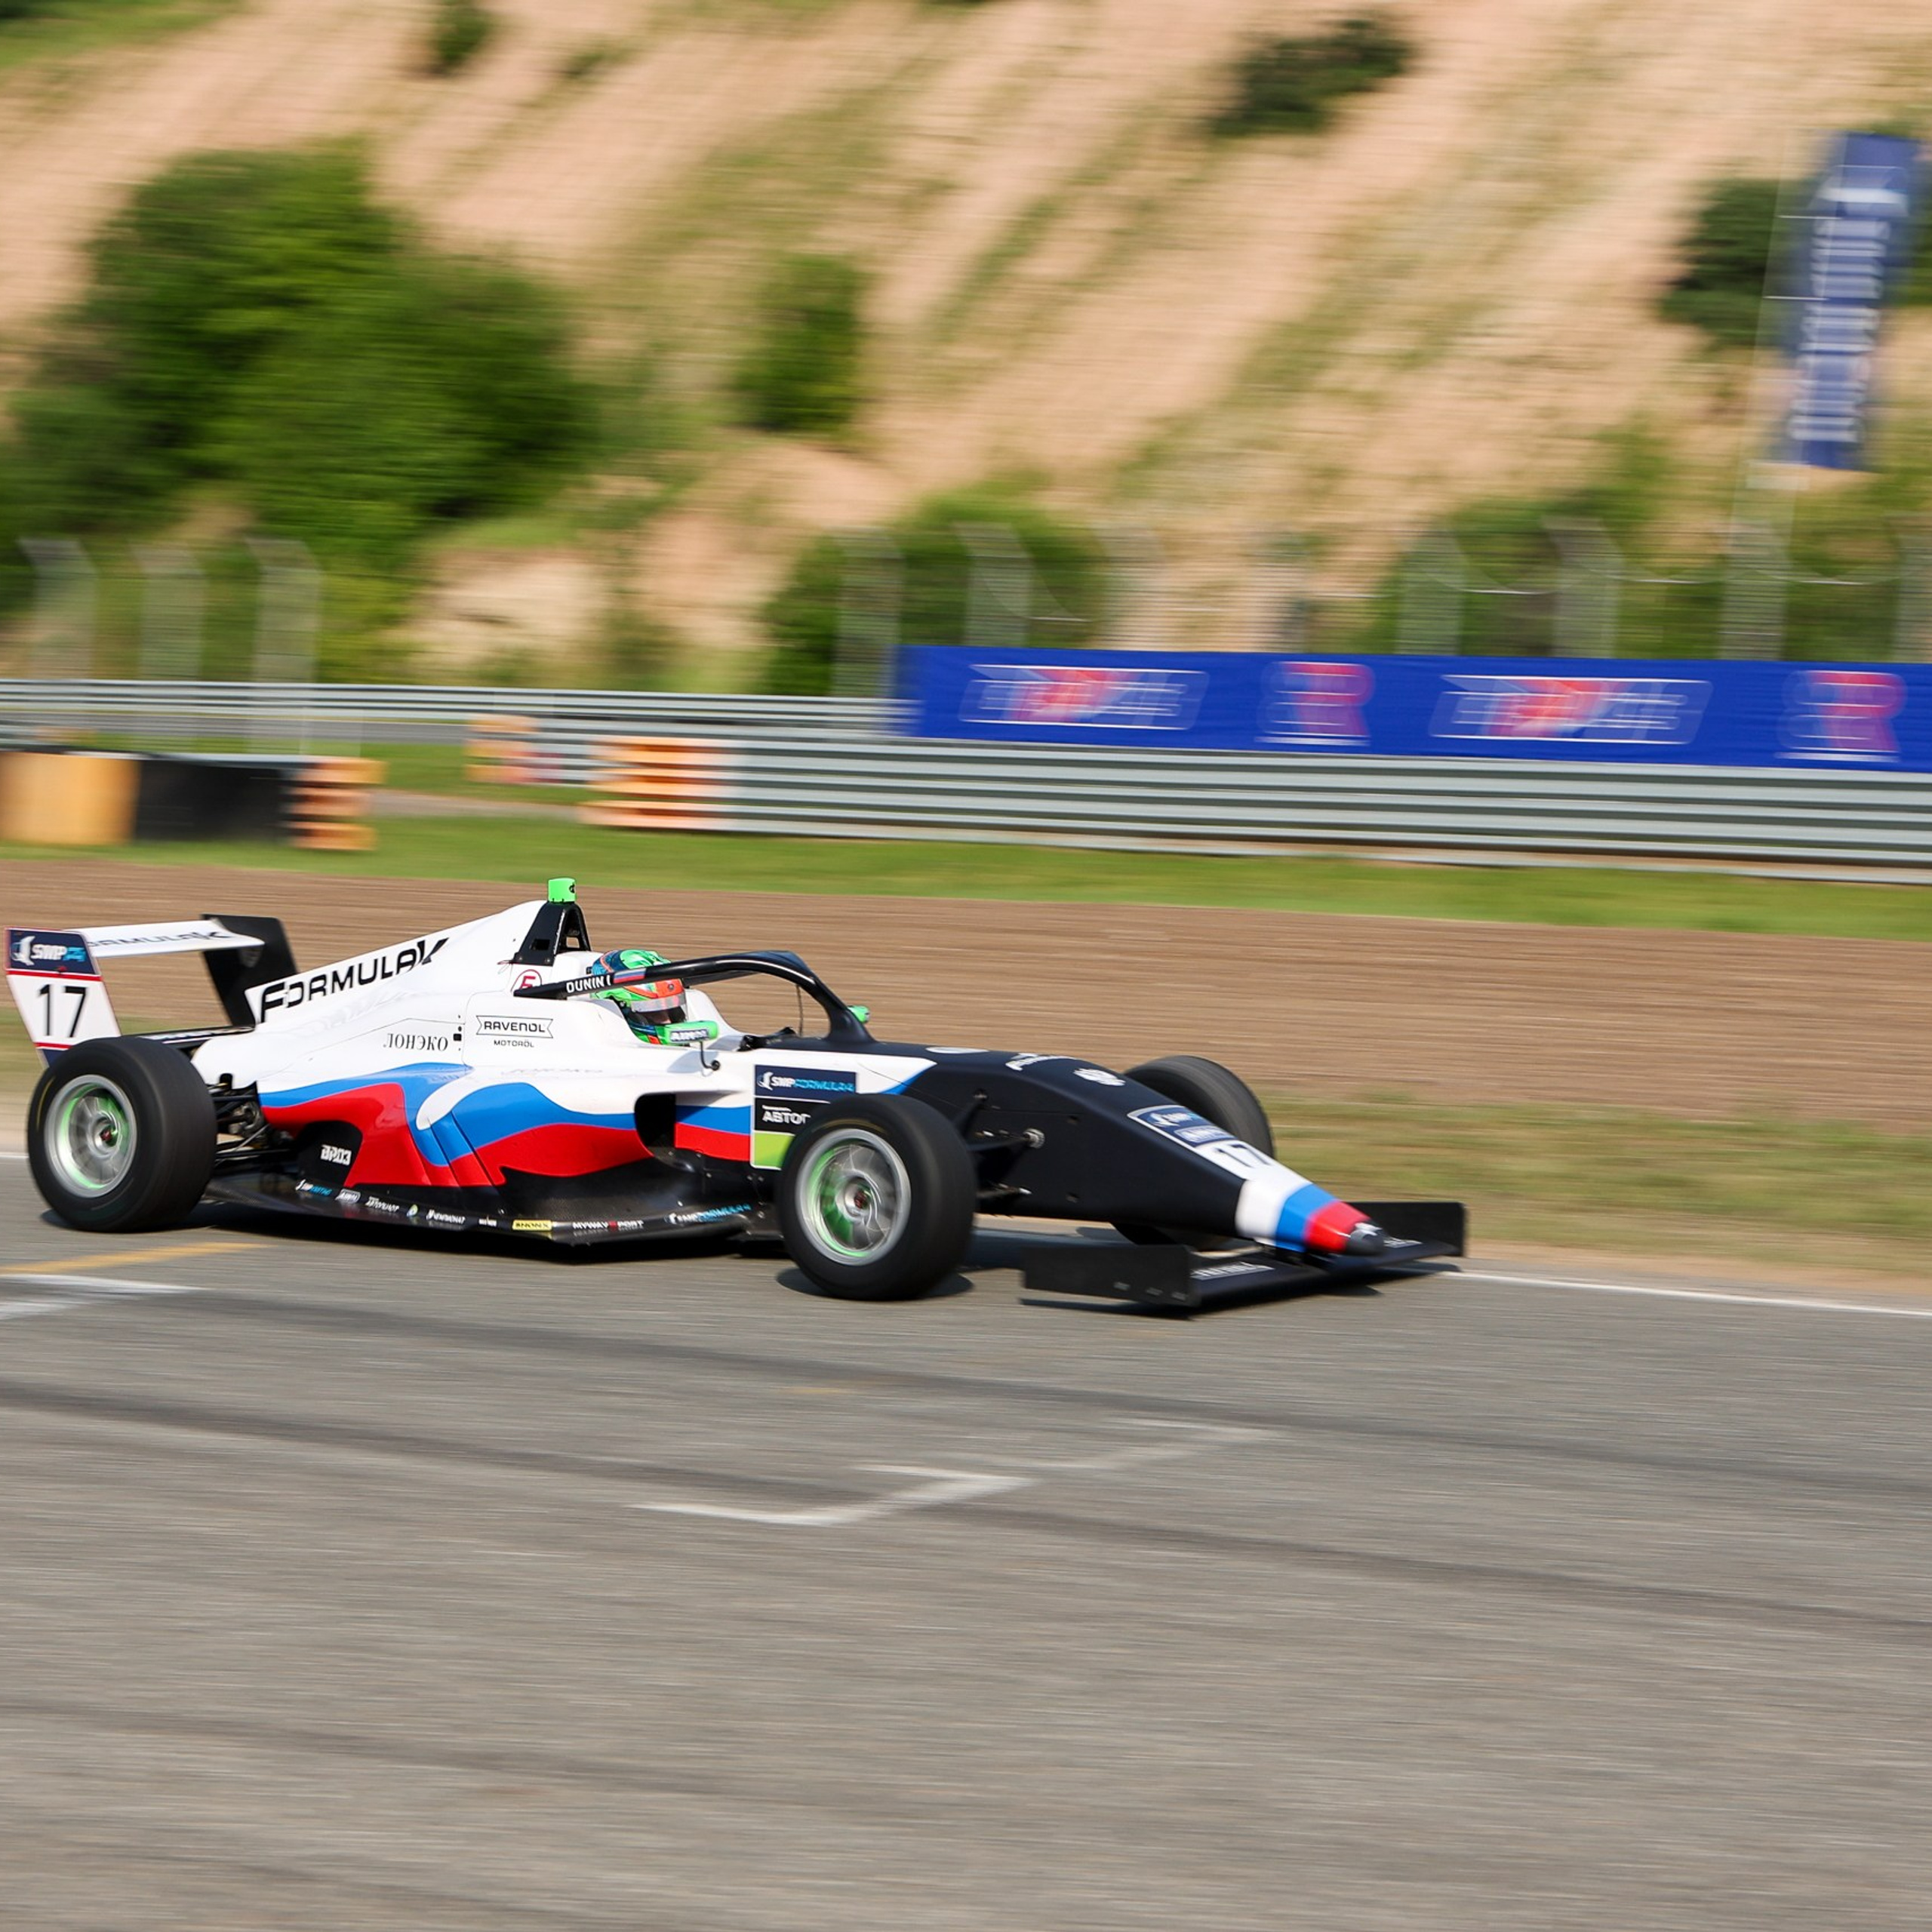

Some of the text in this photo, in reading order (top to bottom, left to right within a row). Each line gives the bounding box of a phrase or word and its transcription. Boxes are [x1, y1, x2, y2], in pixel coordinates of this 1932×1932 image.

[566, 977, 604, 993] DUNIN
[38, 984, 88, 1038] 17
[484, 1021, 546, 1032] RAVENOL
[383, 1033, 448, 1051] ЛОНЭКО
[1214, 1143, 1272, 1168] 17
